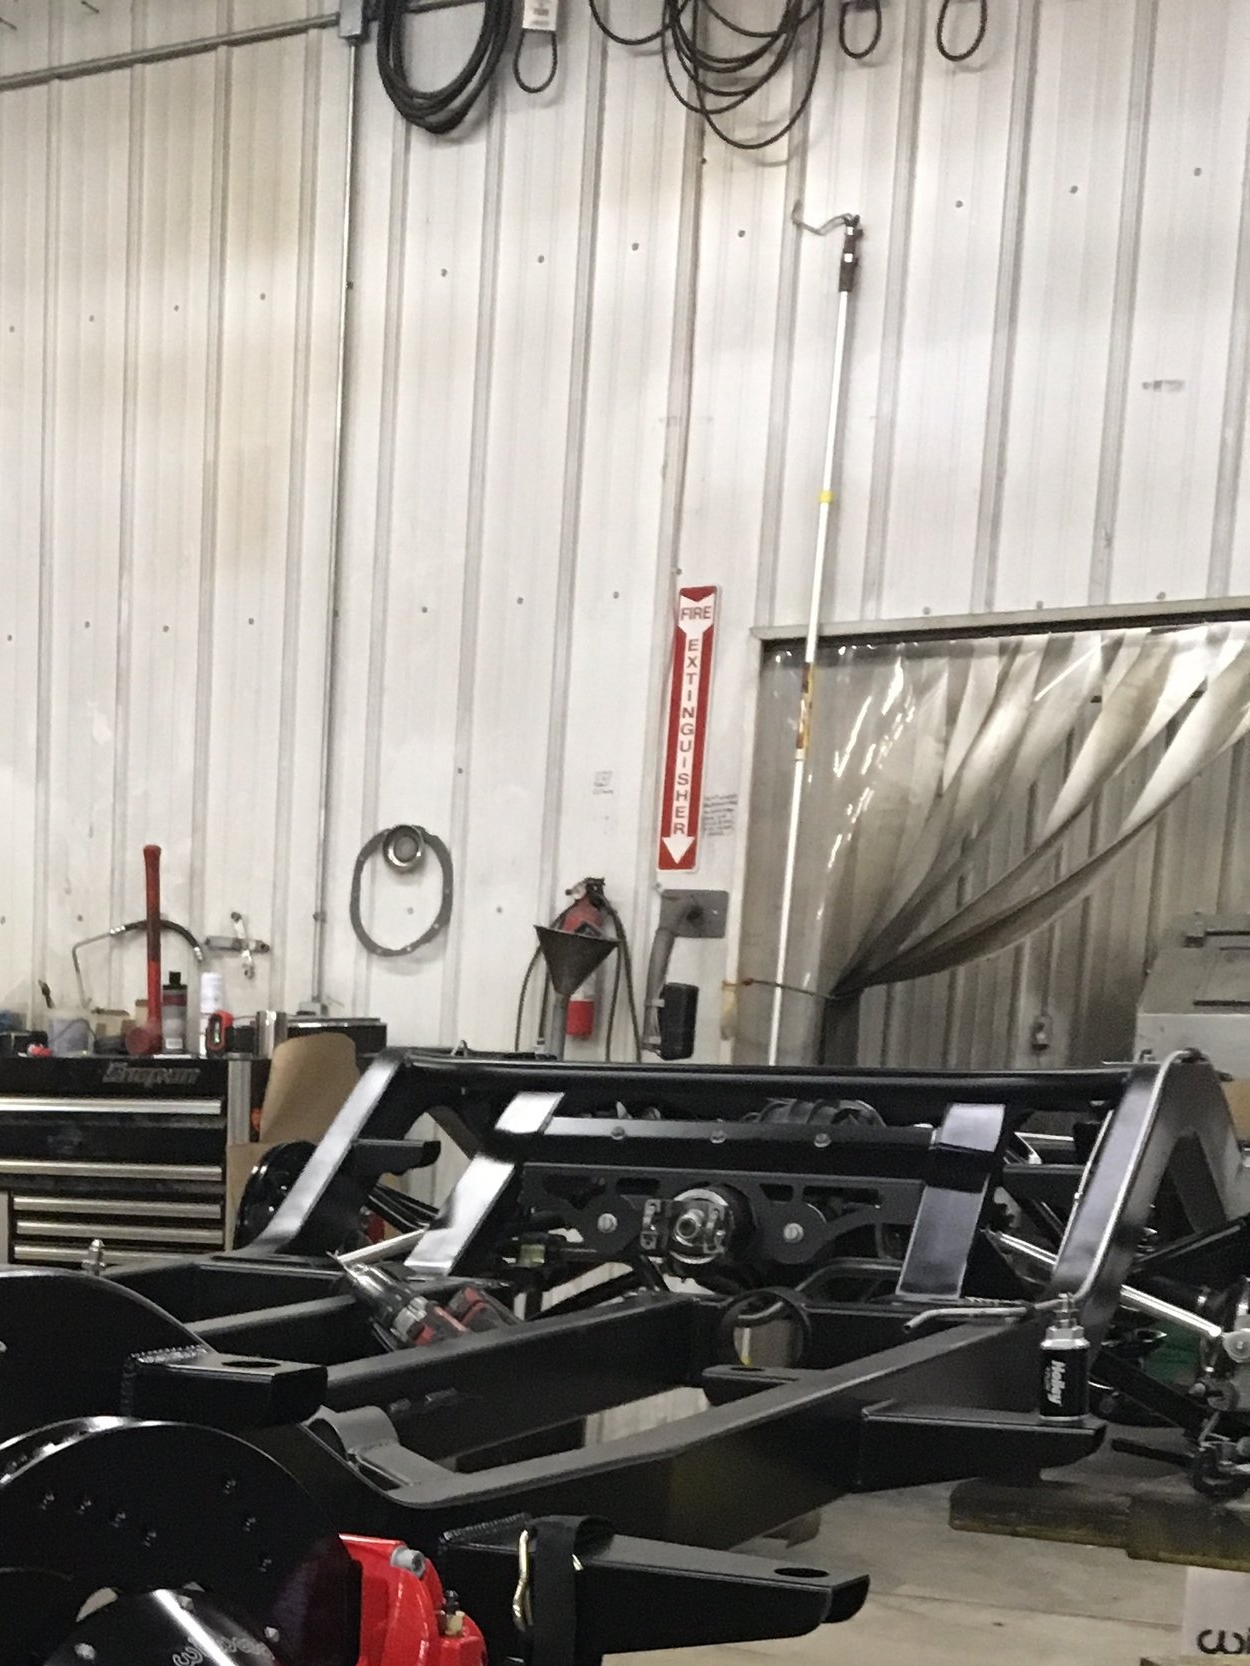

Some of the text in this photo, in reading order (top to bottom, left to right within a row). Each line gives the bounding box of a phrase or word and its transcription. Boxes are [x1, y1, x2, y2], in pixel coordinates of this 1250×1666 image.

[680, 605, 712, 620] FIRE
[672, 638, 699, 836] EXTINGUISHER
[1047, 1359, 1066, 1407] Holley
